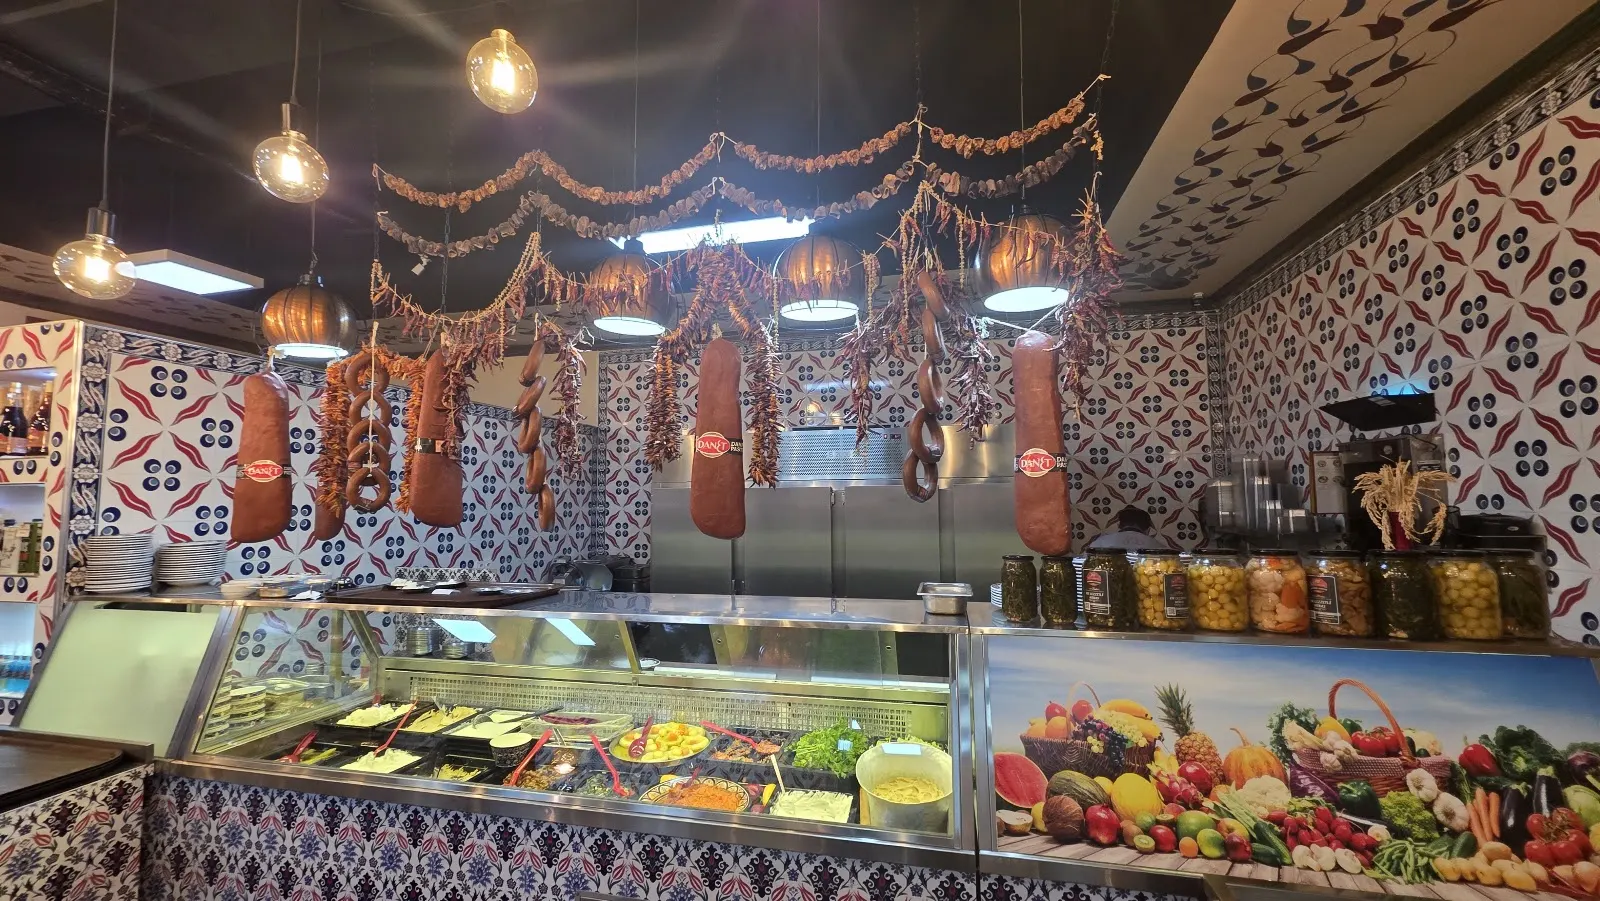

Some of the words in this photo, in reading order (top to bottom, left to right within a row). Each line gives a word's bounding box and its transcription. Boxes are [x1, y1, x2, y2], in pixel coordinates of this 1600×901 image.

[698, 440, 728, 453] DANET
[1021, 456, 1053, 471] DANET
[248, 467, 280, 477] DANET
